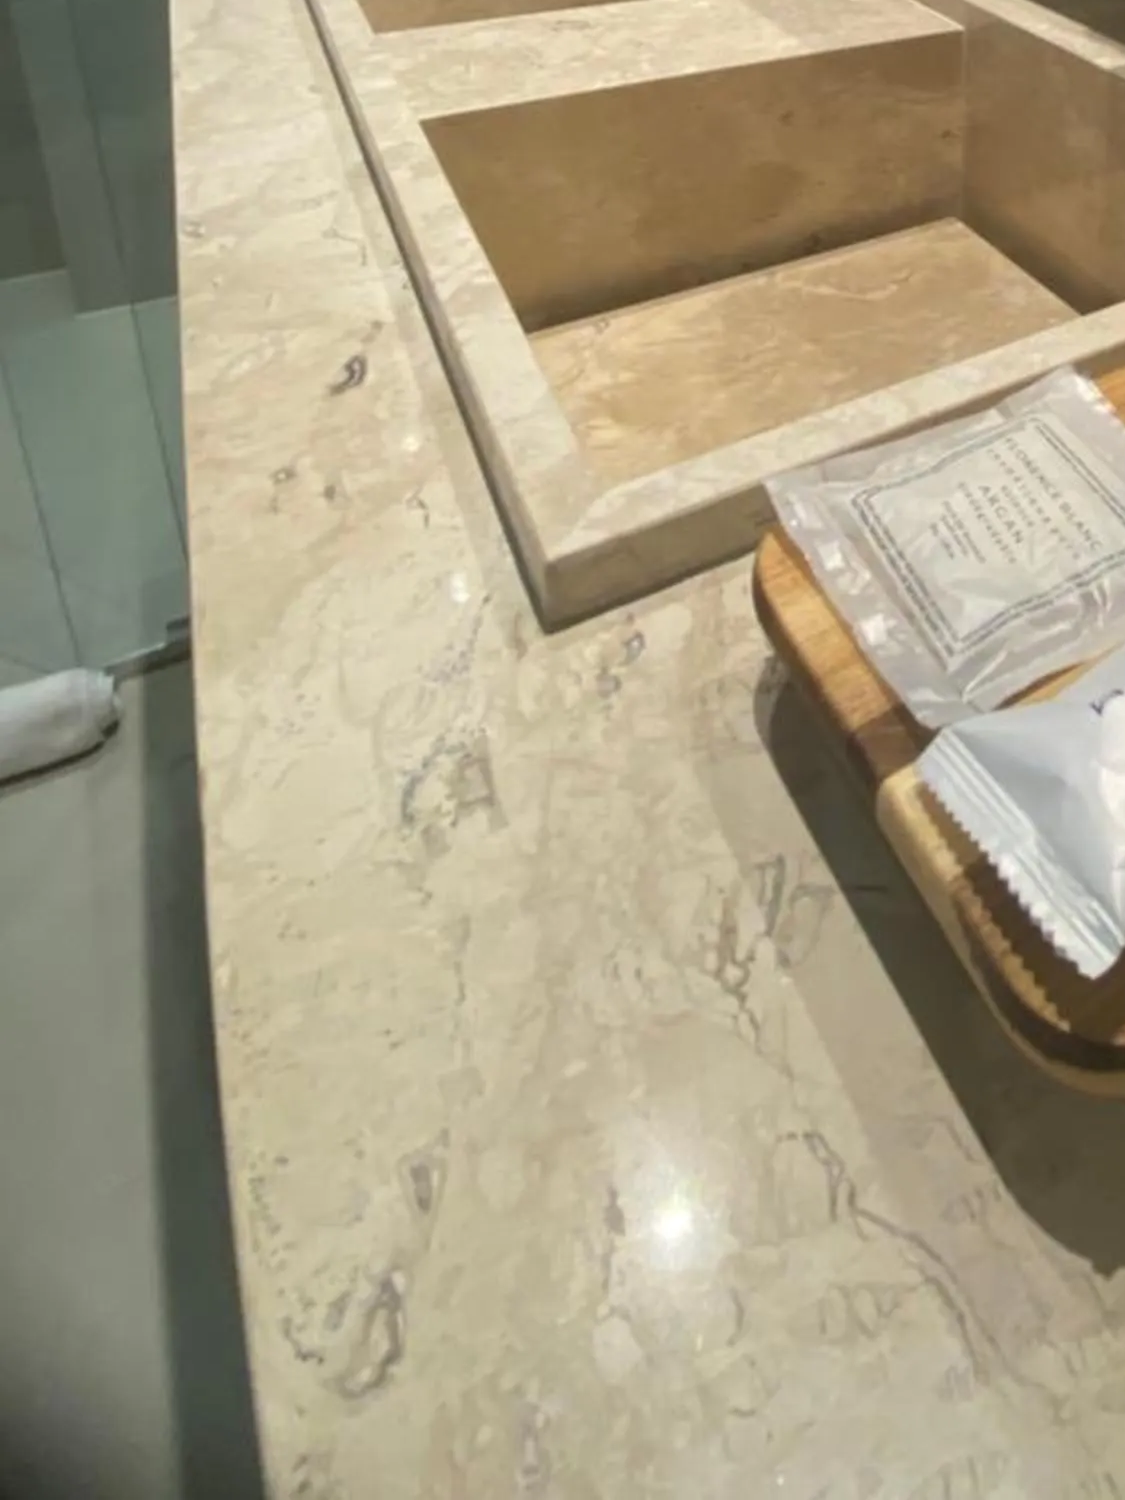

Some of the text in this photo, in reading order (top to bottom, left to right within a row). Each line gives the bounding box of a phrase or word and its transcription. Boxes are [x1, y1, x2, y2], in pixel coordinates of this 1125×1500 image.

[978, 484, 1025, 545] ARGAN
[1005, 437, 1061, 500] FLORENCE
[1058, 500, 1103, 551] BLANC
